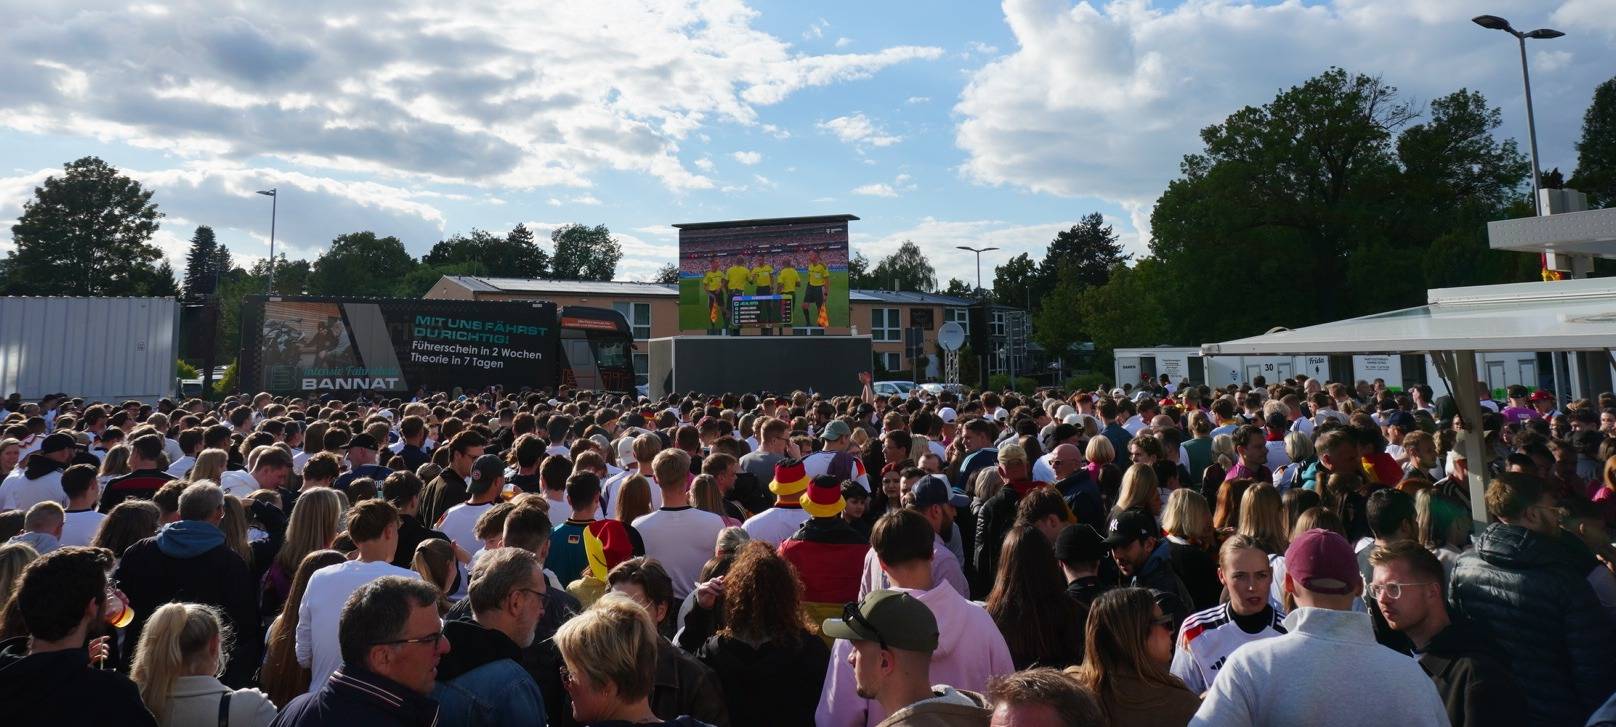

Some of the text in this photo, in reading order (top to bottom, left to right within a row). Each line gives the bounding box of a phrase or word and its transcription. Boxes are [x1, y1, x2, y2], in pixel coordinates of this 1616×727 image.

[415, 315, 446, 326] MIT
[448, 318, 482, 331] UNS
[485, 321, 549, 337] FÄHRST
[414, 327, 510, 344] DU RICHTIG!
[412, 341, 542, 360] Führerschein in 2 Wochen
[410, 352, 504, 370] Theorie in 7 Tagen
[1264, 363, 1274, 372] 30
[301, 377, 400, 390] BANNAT
